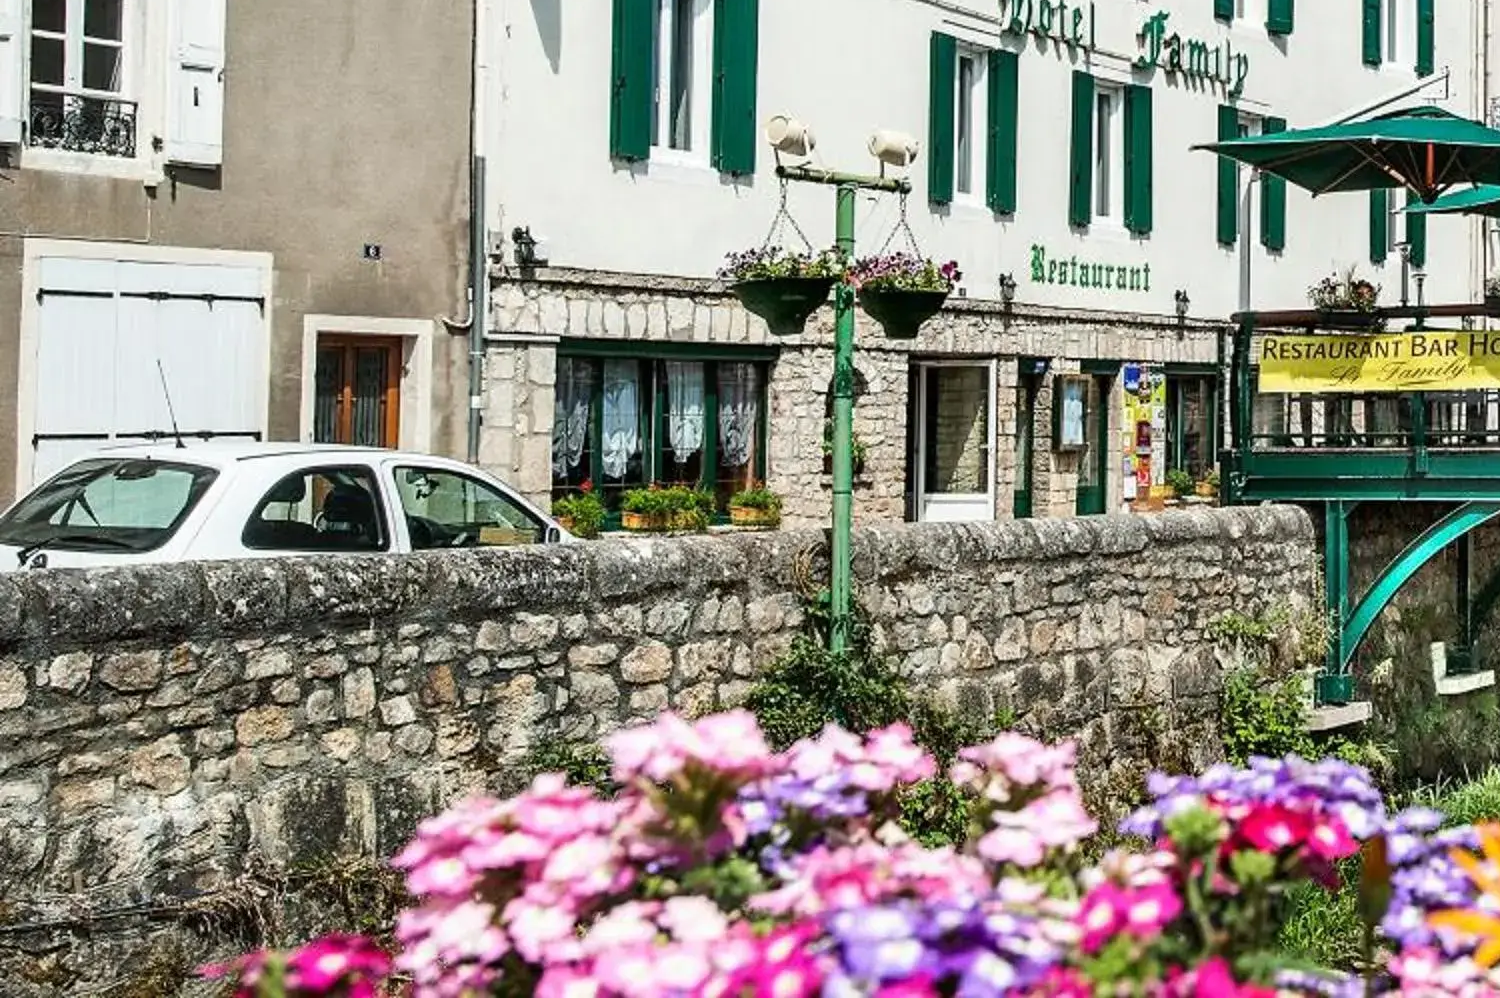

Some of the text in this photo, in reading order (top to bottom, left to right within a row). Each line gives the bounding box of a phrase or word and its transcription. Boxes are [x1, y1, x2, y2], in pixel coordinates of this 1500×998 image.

[1136, 10, 1249, 100] Family
[1031, 243, 1151, 292] Restaurant
[1262, 338, 1402, 360] RESTAURANT
[1411, 335, 1459, 357] BAR
[1376, 356, 1467, 384] Family
